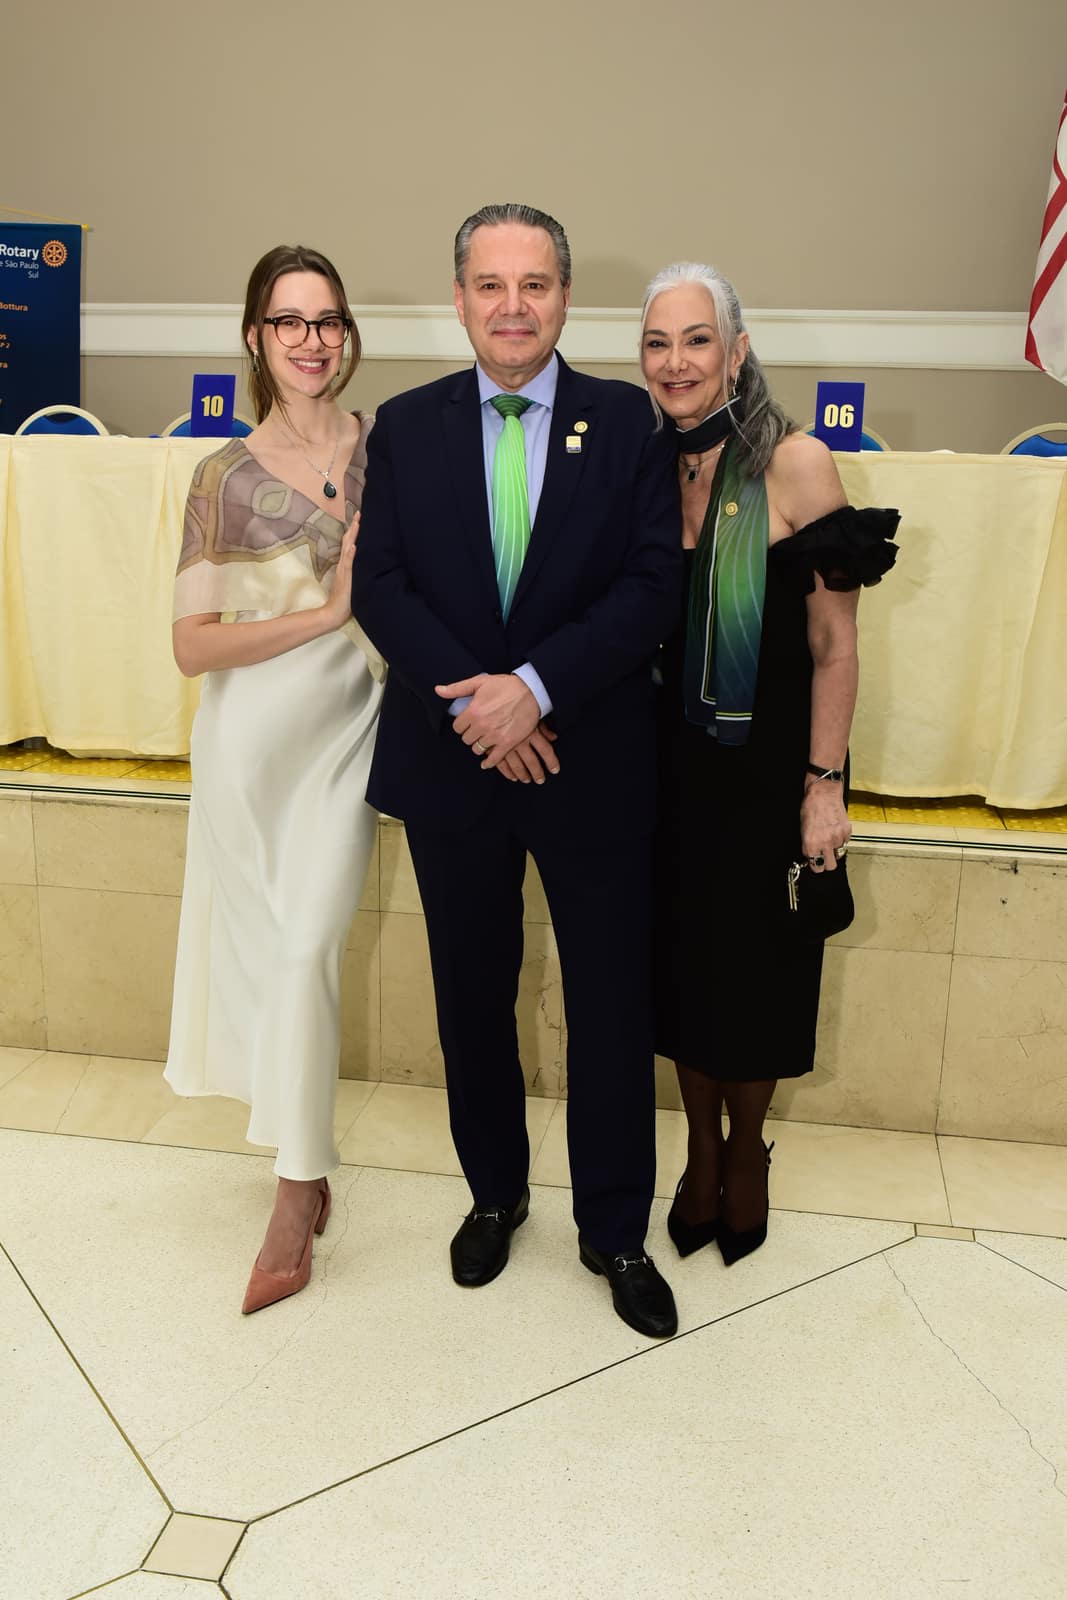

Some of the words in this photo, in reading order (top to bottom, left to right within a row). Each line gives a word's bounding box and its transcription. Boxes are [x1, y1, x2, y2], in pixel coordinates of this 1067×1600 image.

[0, 243, 39, 260] Rotary
[4, 259, 18, 268] São
[19, 260, 39, 270] Paulo
[27, 270, 39, 279] Sul
[201, 395, 224, 417] 10
[823, 403, 855, 428] 06
